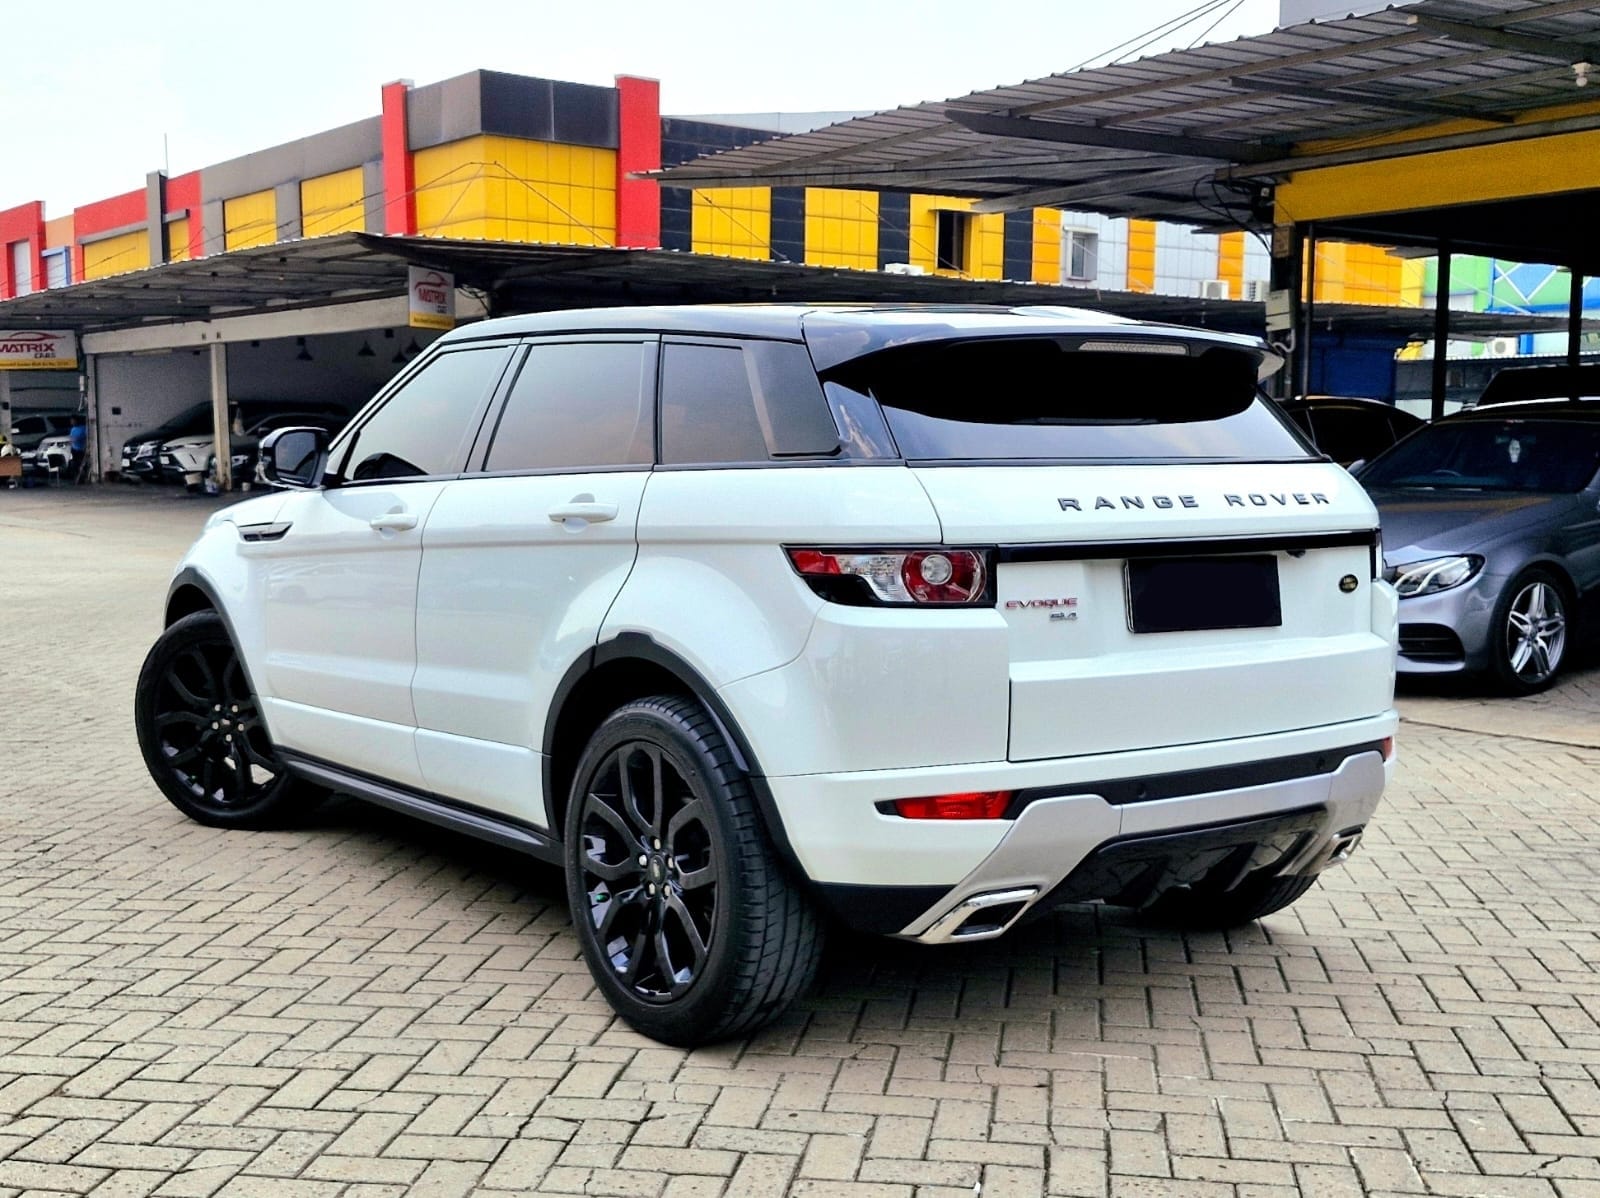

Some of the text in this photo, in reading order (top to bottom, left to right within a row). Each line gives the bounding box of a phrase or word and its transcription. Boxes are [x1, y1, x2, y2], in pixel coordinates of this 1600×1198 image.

[1057, 492, 1330, 511] RANGE ROVER
[1005, 597, 1078, 609] EVOQUE
